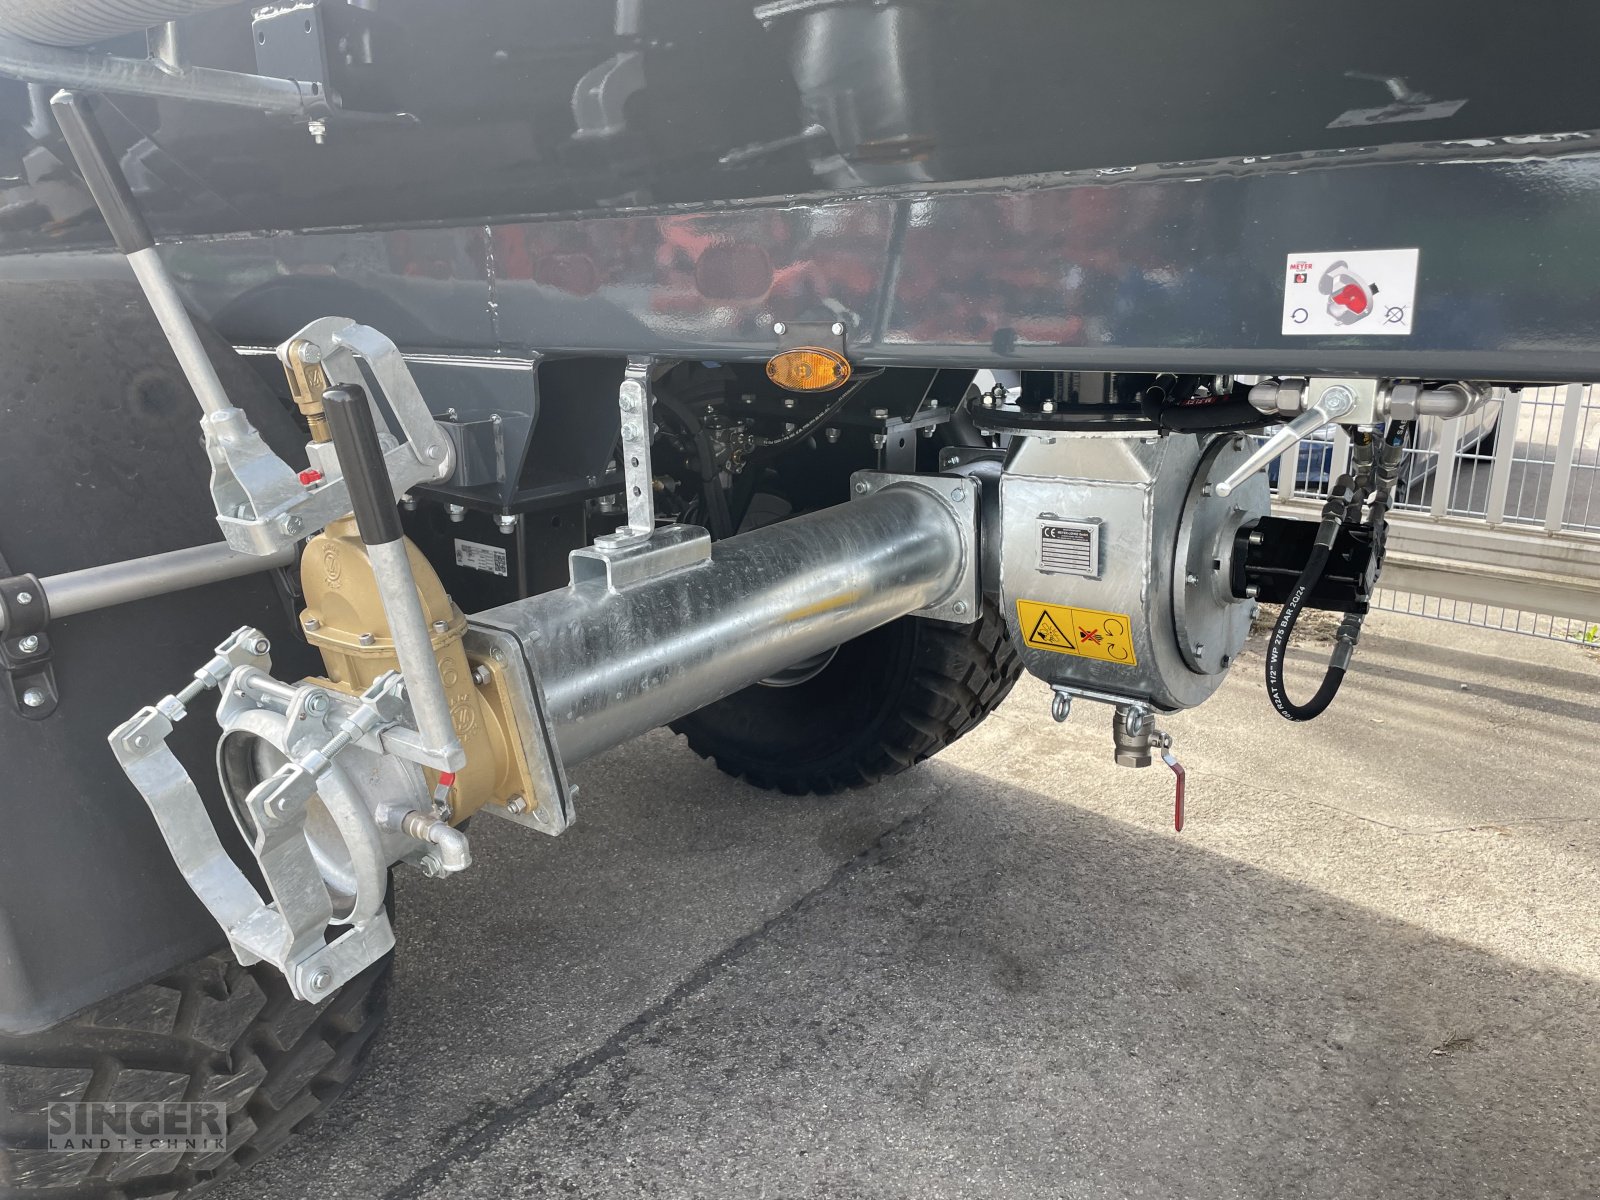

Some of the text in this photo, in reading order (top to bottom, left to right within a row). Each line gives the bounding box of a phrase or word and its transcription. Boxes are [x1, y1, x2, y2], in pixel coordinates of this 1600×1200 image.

[1290, 586, 1306, 608] 2Q/24
[1280, 608, 1294, 628] BAR
[1274, 629, 1285, 645] 275
[1271, 647, 1279, 663] WP
[1271, 687, 1285, 710] R2AT
